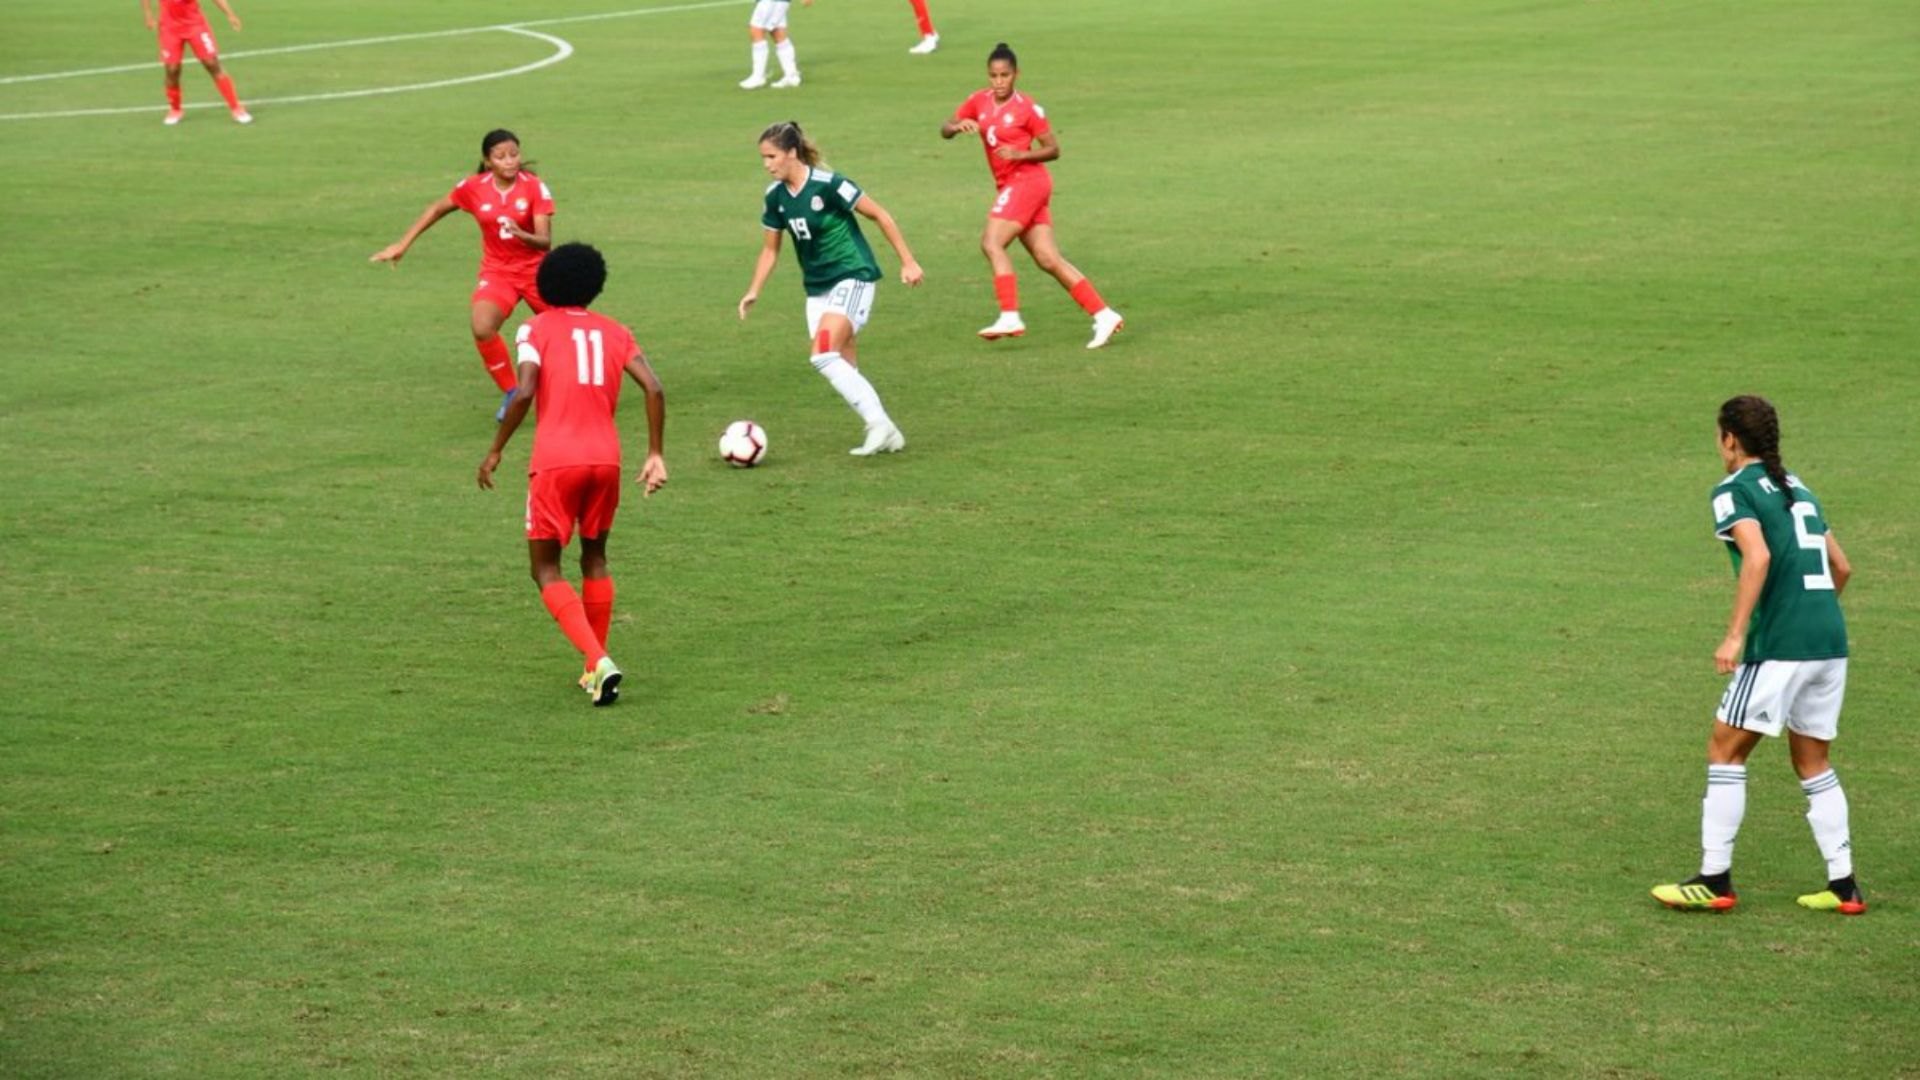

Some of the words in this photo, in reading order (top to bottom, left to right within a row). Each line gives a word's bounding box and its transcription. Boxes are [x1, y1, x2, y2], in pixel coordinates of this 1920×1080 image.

[986, 126, 997, 146] 6
[498, 216, 515, 239] 2
[788, 217, 811, 239] 19
[571, 329, 604, 386] 11
[1790, 501, 1836, 590] 5
